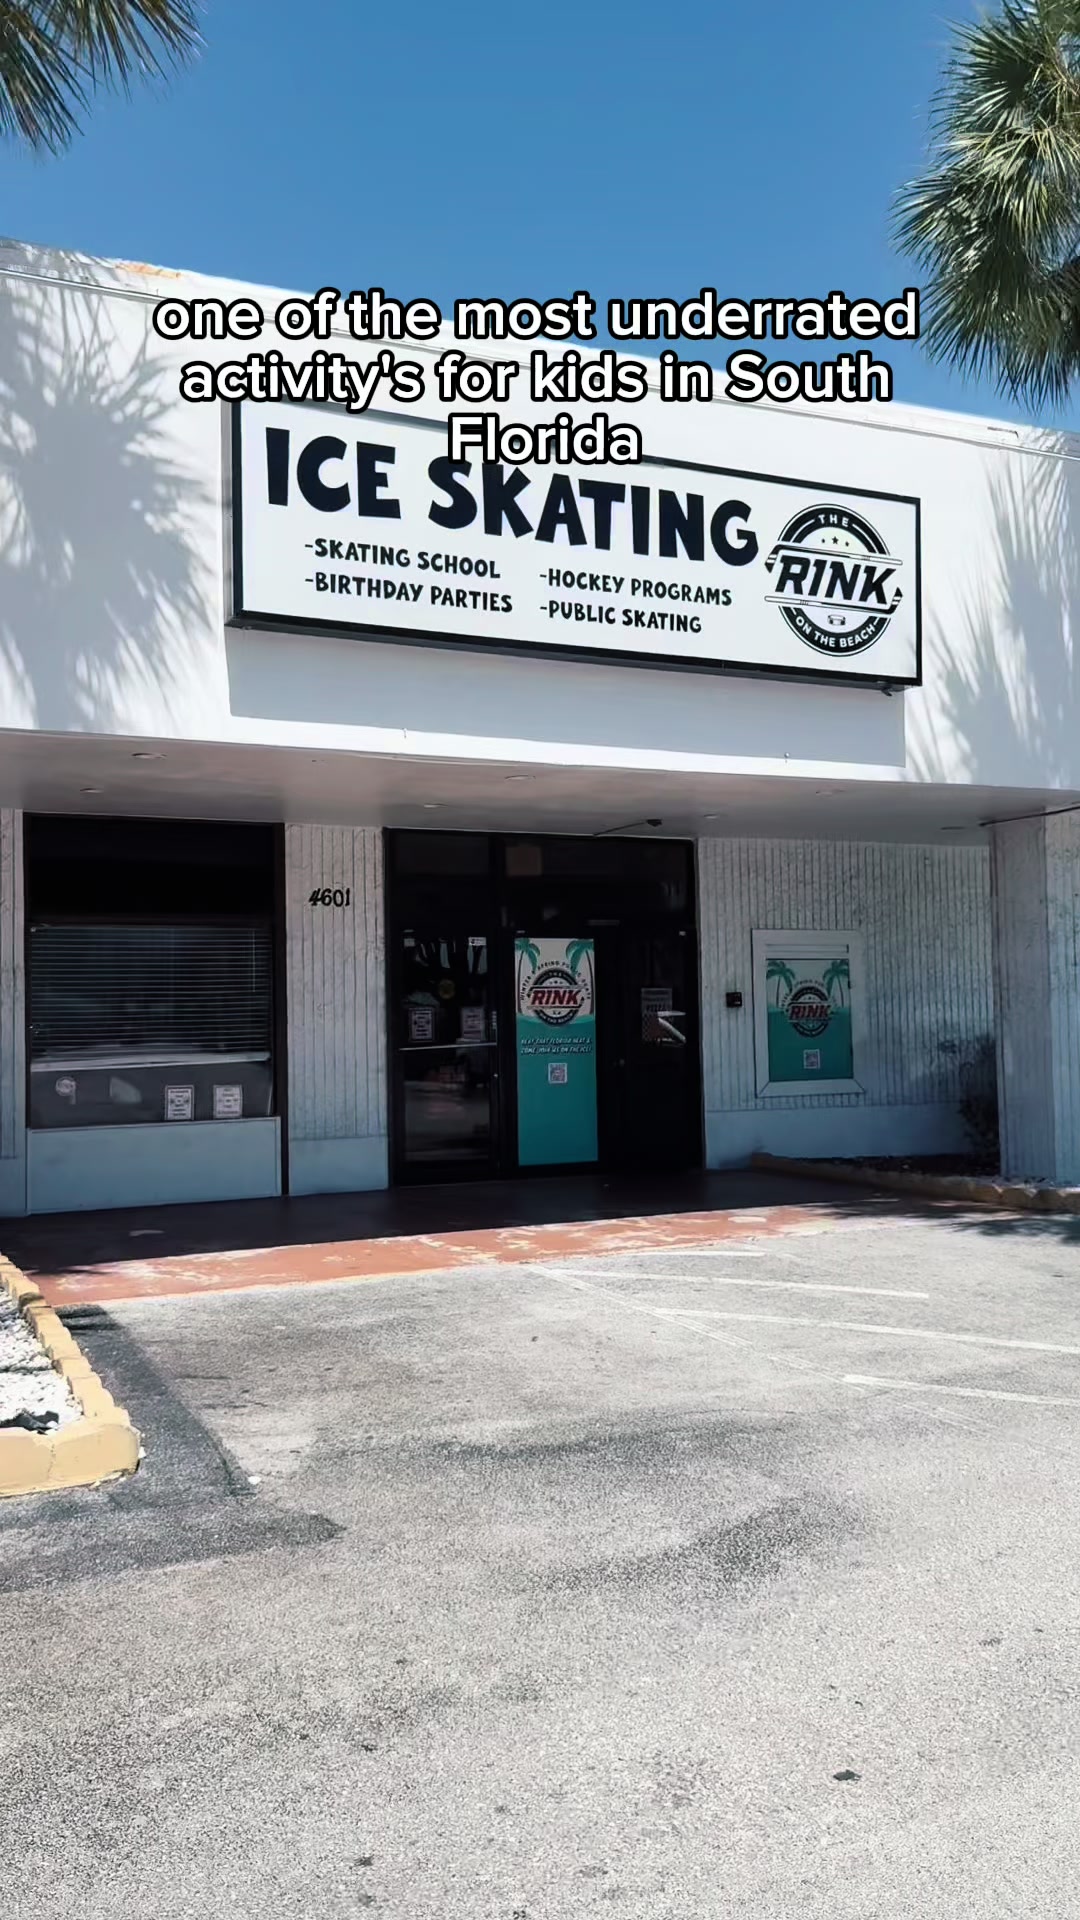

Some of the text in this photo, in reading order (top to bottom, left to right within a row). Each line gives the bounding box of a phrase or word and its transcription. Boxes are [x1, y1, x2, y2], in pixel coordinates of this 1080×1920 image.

[265, 427, 759, 568] ICE SKATING
[818, 513, 849, 527] THE
[417, 551, 501, 579] SCHOOL
[631, 579, 732, 607] PROGRAMS
[775, 554, 896, 605] RINK
[430, 585, 513, 613] PARTIES
[622, 609, 702, 634] SKATING
[796, 616, 877, 648] ON THE BEACH
[308, 887, 351, 907] 4601
[531, 989, 582, 1006] RINK
